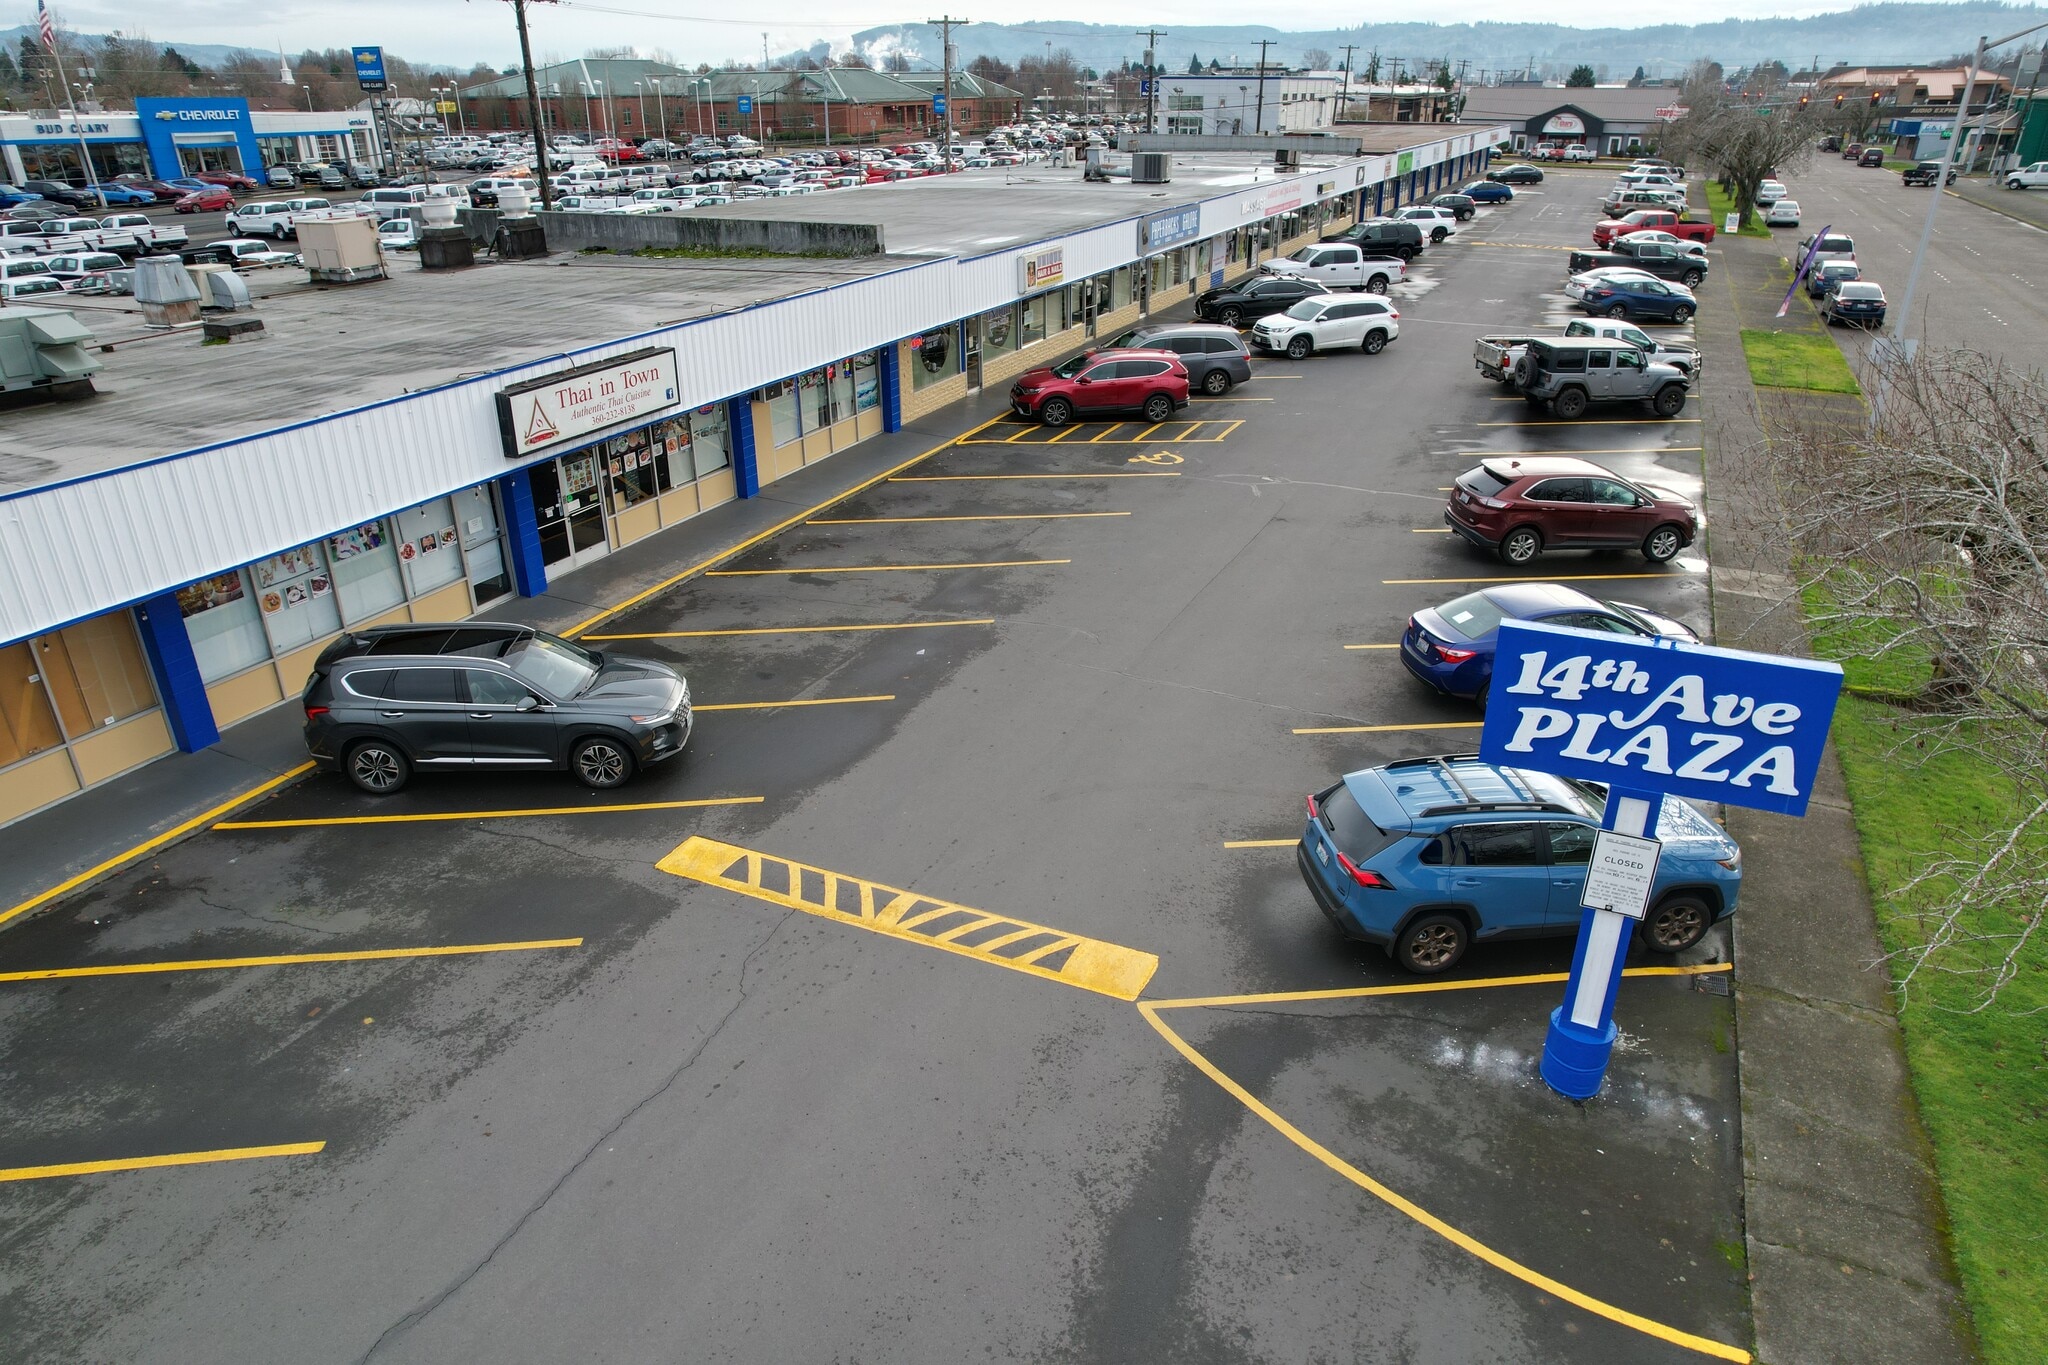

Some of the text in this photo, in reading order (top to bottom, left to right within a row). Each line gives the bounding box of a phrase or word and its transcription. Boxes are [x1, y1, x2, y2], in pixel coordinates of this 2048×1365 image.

[178, 110, 240, 121] CHEVROLET
[36, 123, 109, 134] BUD CLARY
[1037, 267, 1047, 278] HAIR
[1051, 263, 1062, 274] NAILS
[555, 367, 660, 409] Thai in Town
[571, 389, 651, 420] Authentic Thai Cuisine
[592, 404, 636, 426] 360-232-8138
[1506, 651, 1802, 735] 14th Ave
[1504, 707, 1800, 796] PLAZA
[1604, 855, 1644, 870] CLOSED
